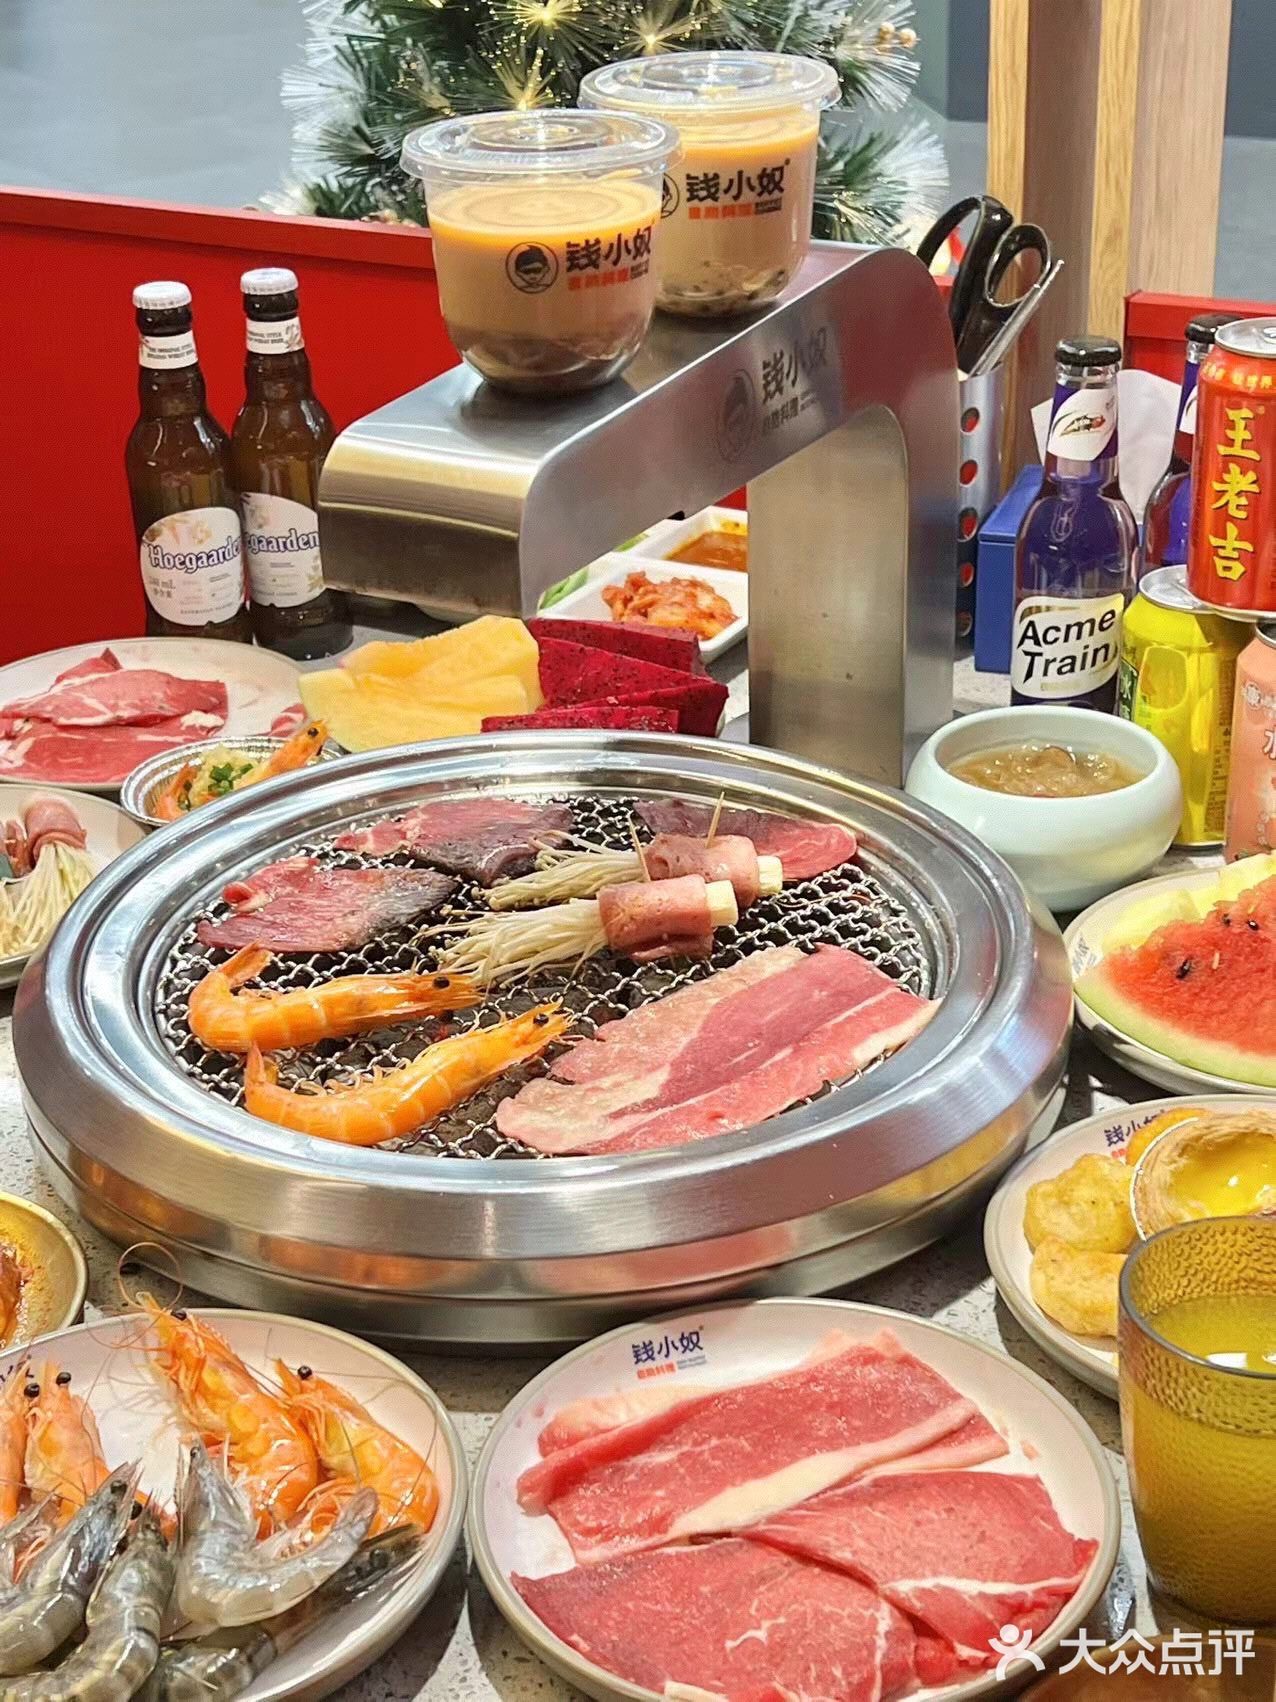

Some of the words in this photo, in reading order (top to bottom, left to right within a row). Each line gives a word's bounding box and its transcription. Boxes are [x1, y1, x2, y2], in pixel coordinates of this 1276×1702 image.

[686, 166, 784, 202] 钱小奴
[566, 226, 651, 273] 钱小奴
[762, 327, 827, 405] 钱小奴
[1208, 407, 1262, 581] 王老吉
[1017, 608, 1116, 650] Acme
[1021, 642, 1110, 684] Train
[1104, 1114, 1159, 1147] 钱小
[631, 1331, 704, 1365] 钱小奴
